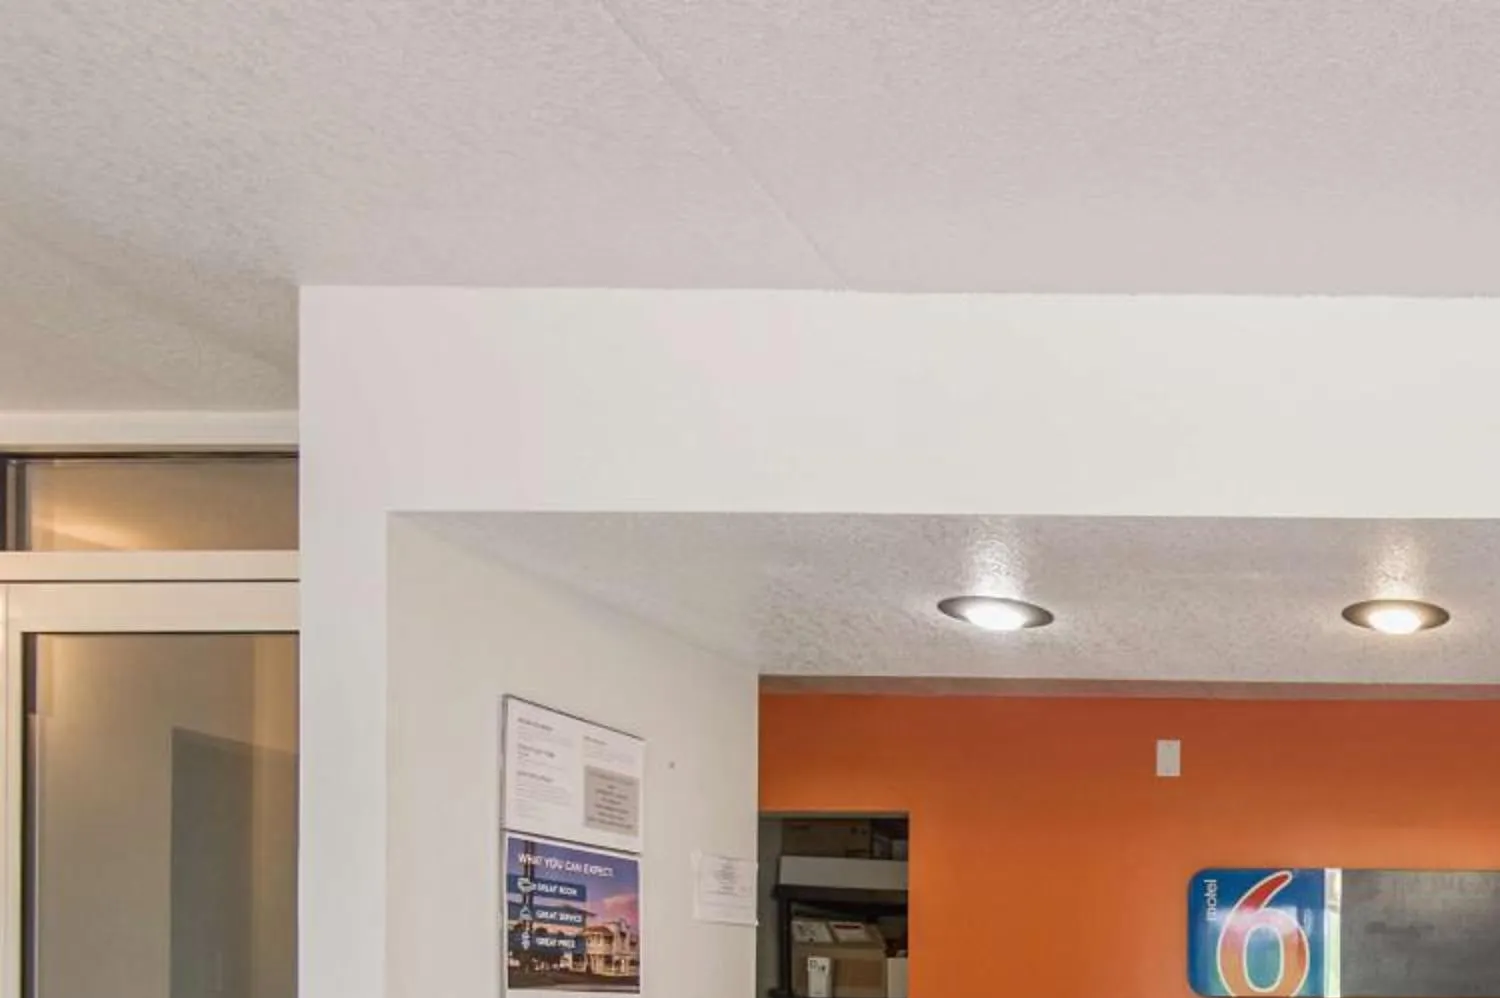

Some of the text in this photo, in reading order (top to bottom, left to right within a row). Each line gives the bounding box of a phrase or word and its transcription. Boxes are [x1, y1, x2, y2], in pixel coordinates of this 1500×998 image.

[518, 853, 614, 877] WHAT YOU CAN EXPECT
[1203, 879, 1218, 921] motel
[1215, 870, 1311, 997] 6
